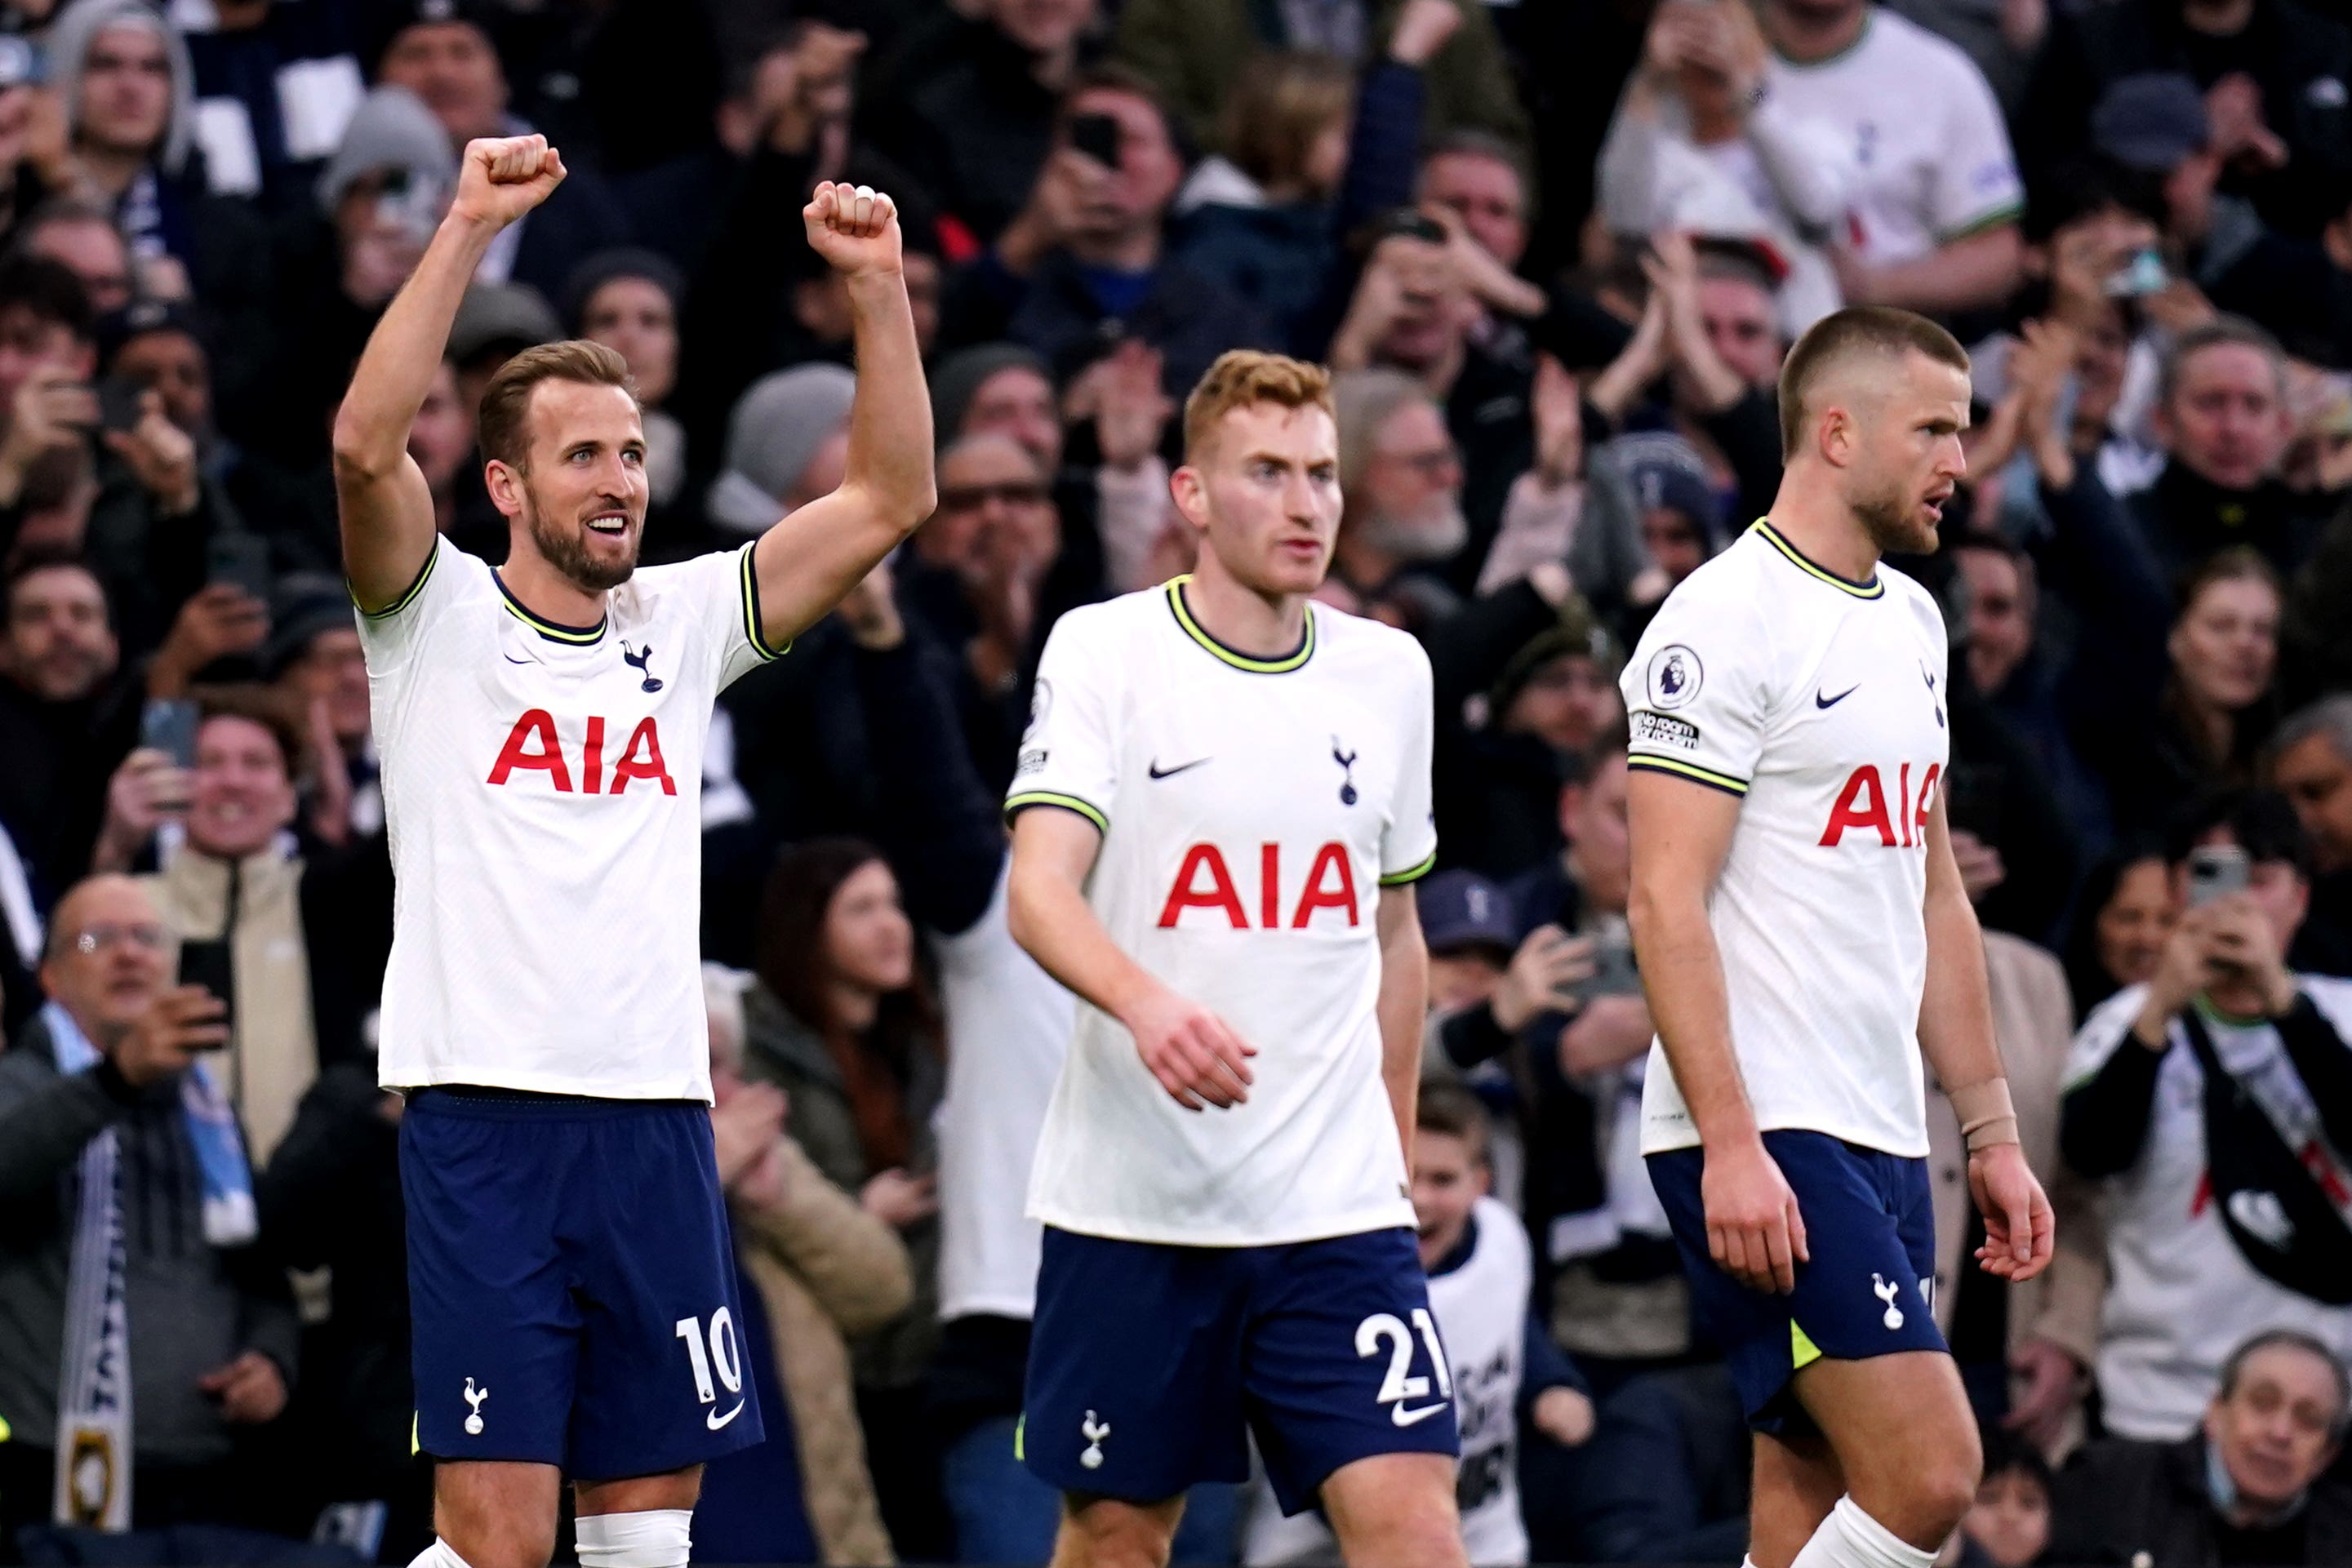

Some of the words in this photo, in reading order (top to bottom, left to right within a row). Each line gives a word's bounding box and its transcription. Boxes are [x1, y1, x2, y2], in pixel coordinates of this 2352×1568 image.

[487, 708, 677, 796] AIA
[1656, 717, 1694, 738] room
[1157, 842, 1359, 929] AIA
[676, 1306, 741, 1403] 10
[1354, 1308, 1452, 1404] 21
